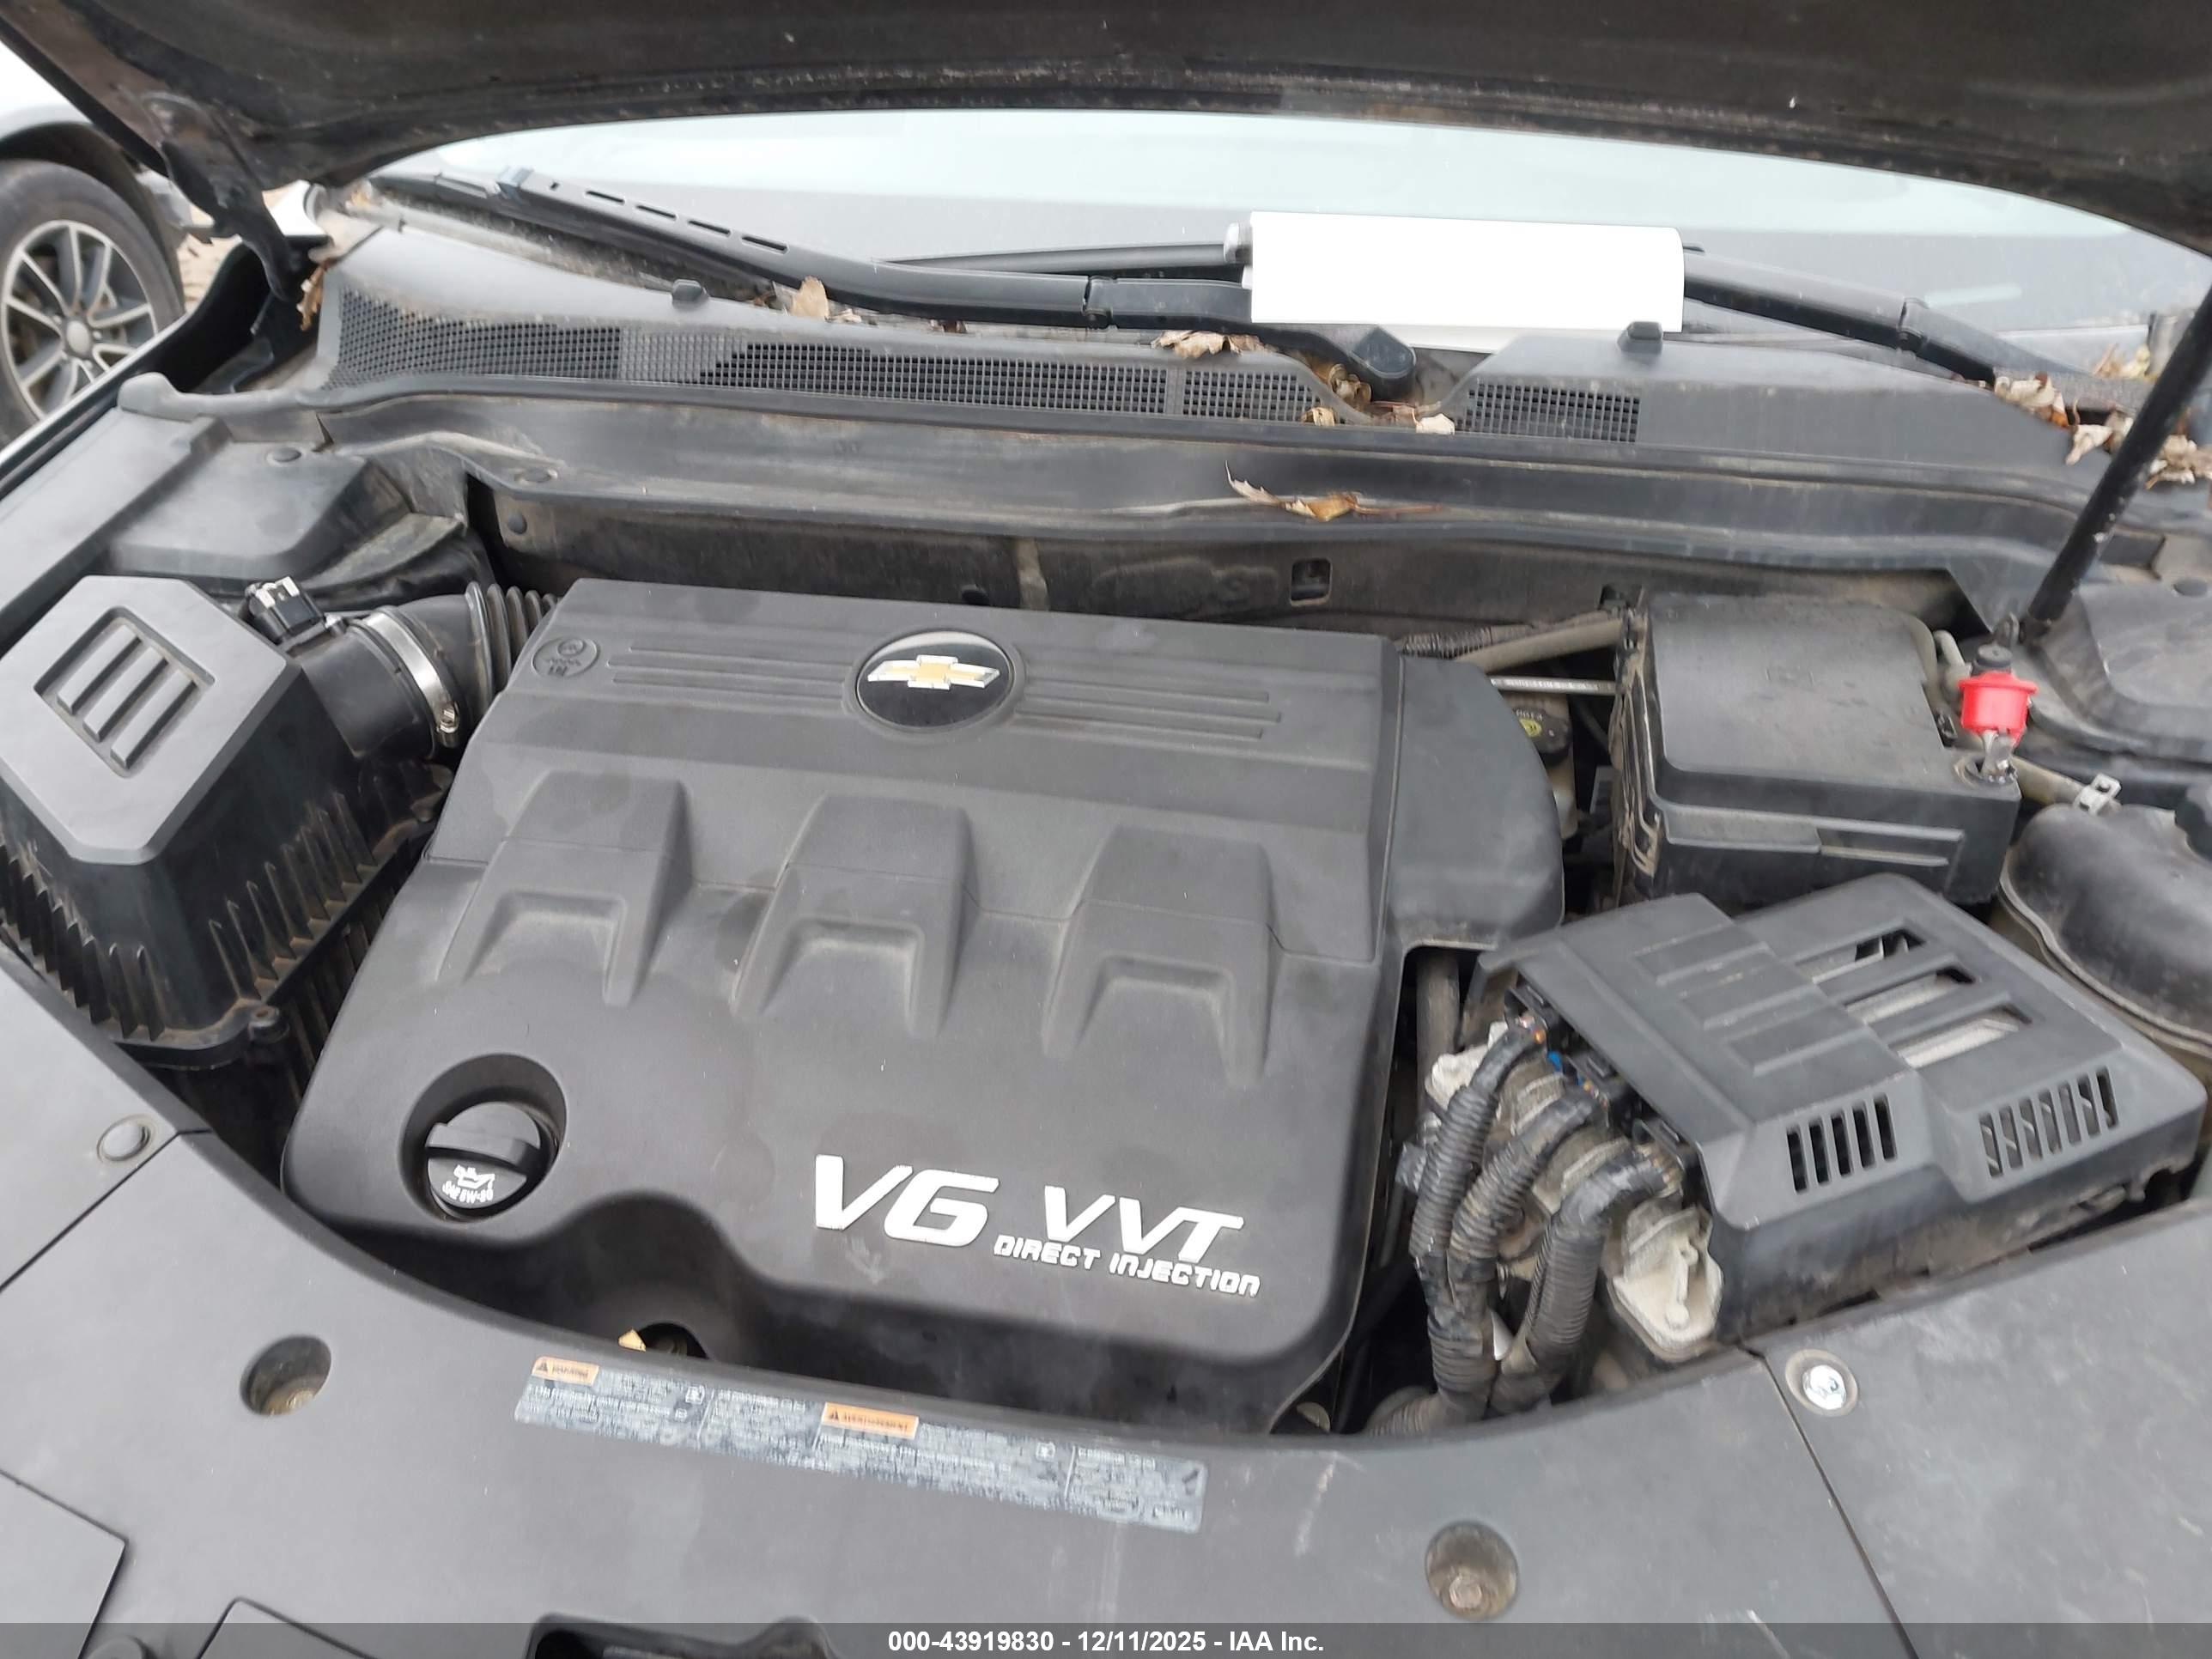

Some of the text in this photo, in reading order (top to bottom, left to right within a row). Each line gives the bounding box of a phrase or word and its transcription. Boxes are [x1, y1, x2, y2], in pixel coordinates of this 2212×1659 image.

[1044, 1185, 1244, 1264] VVT
[994, 1235, 1261, 1297] DIRECT INJECTION
